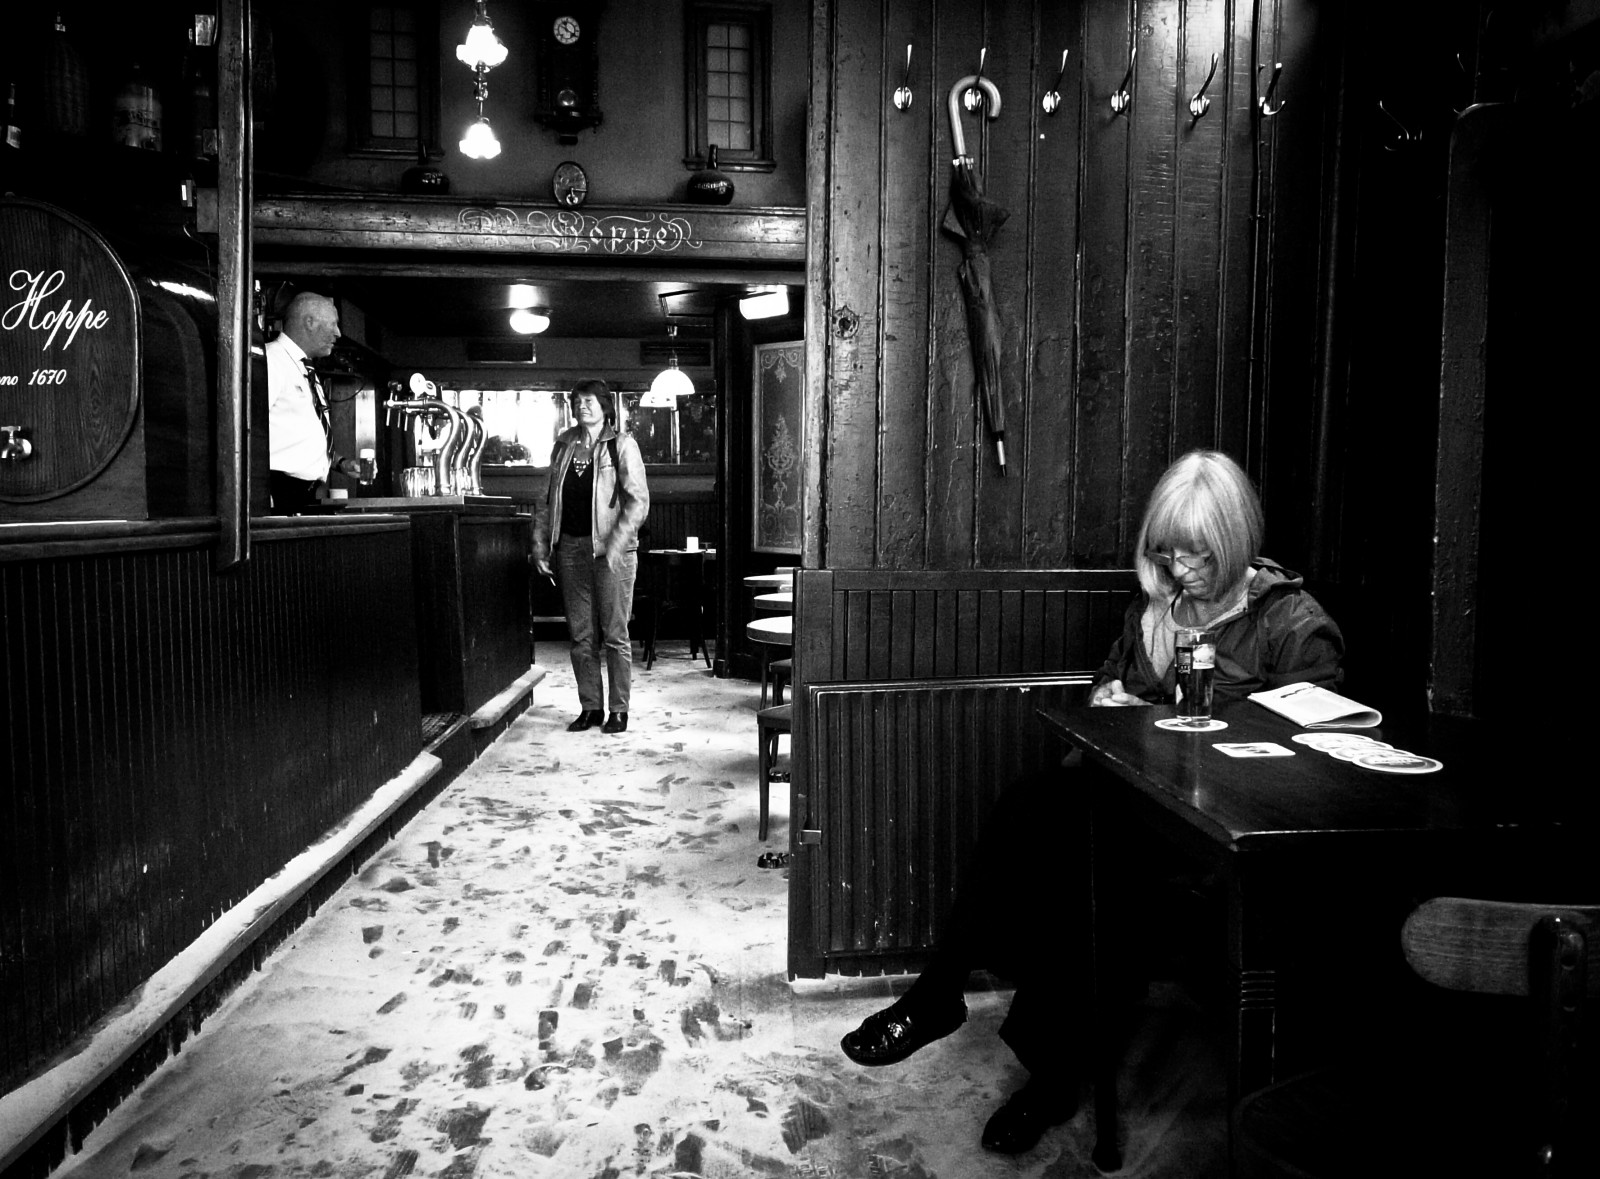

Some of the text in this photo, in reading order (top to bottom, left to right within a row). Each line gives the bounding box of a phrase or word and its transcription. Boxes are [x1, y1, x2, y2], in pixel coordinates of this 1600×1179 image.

[1, 269, 110, 351] Hoppe
[0, 368, 67, 386] no 1670
